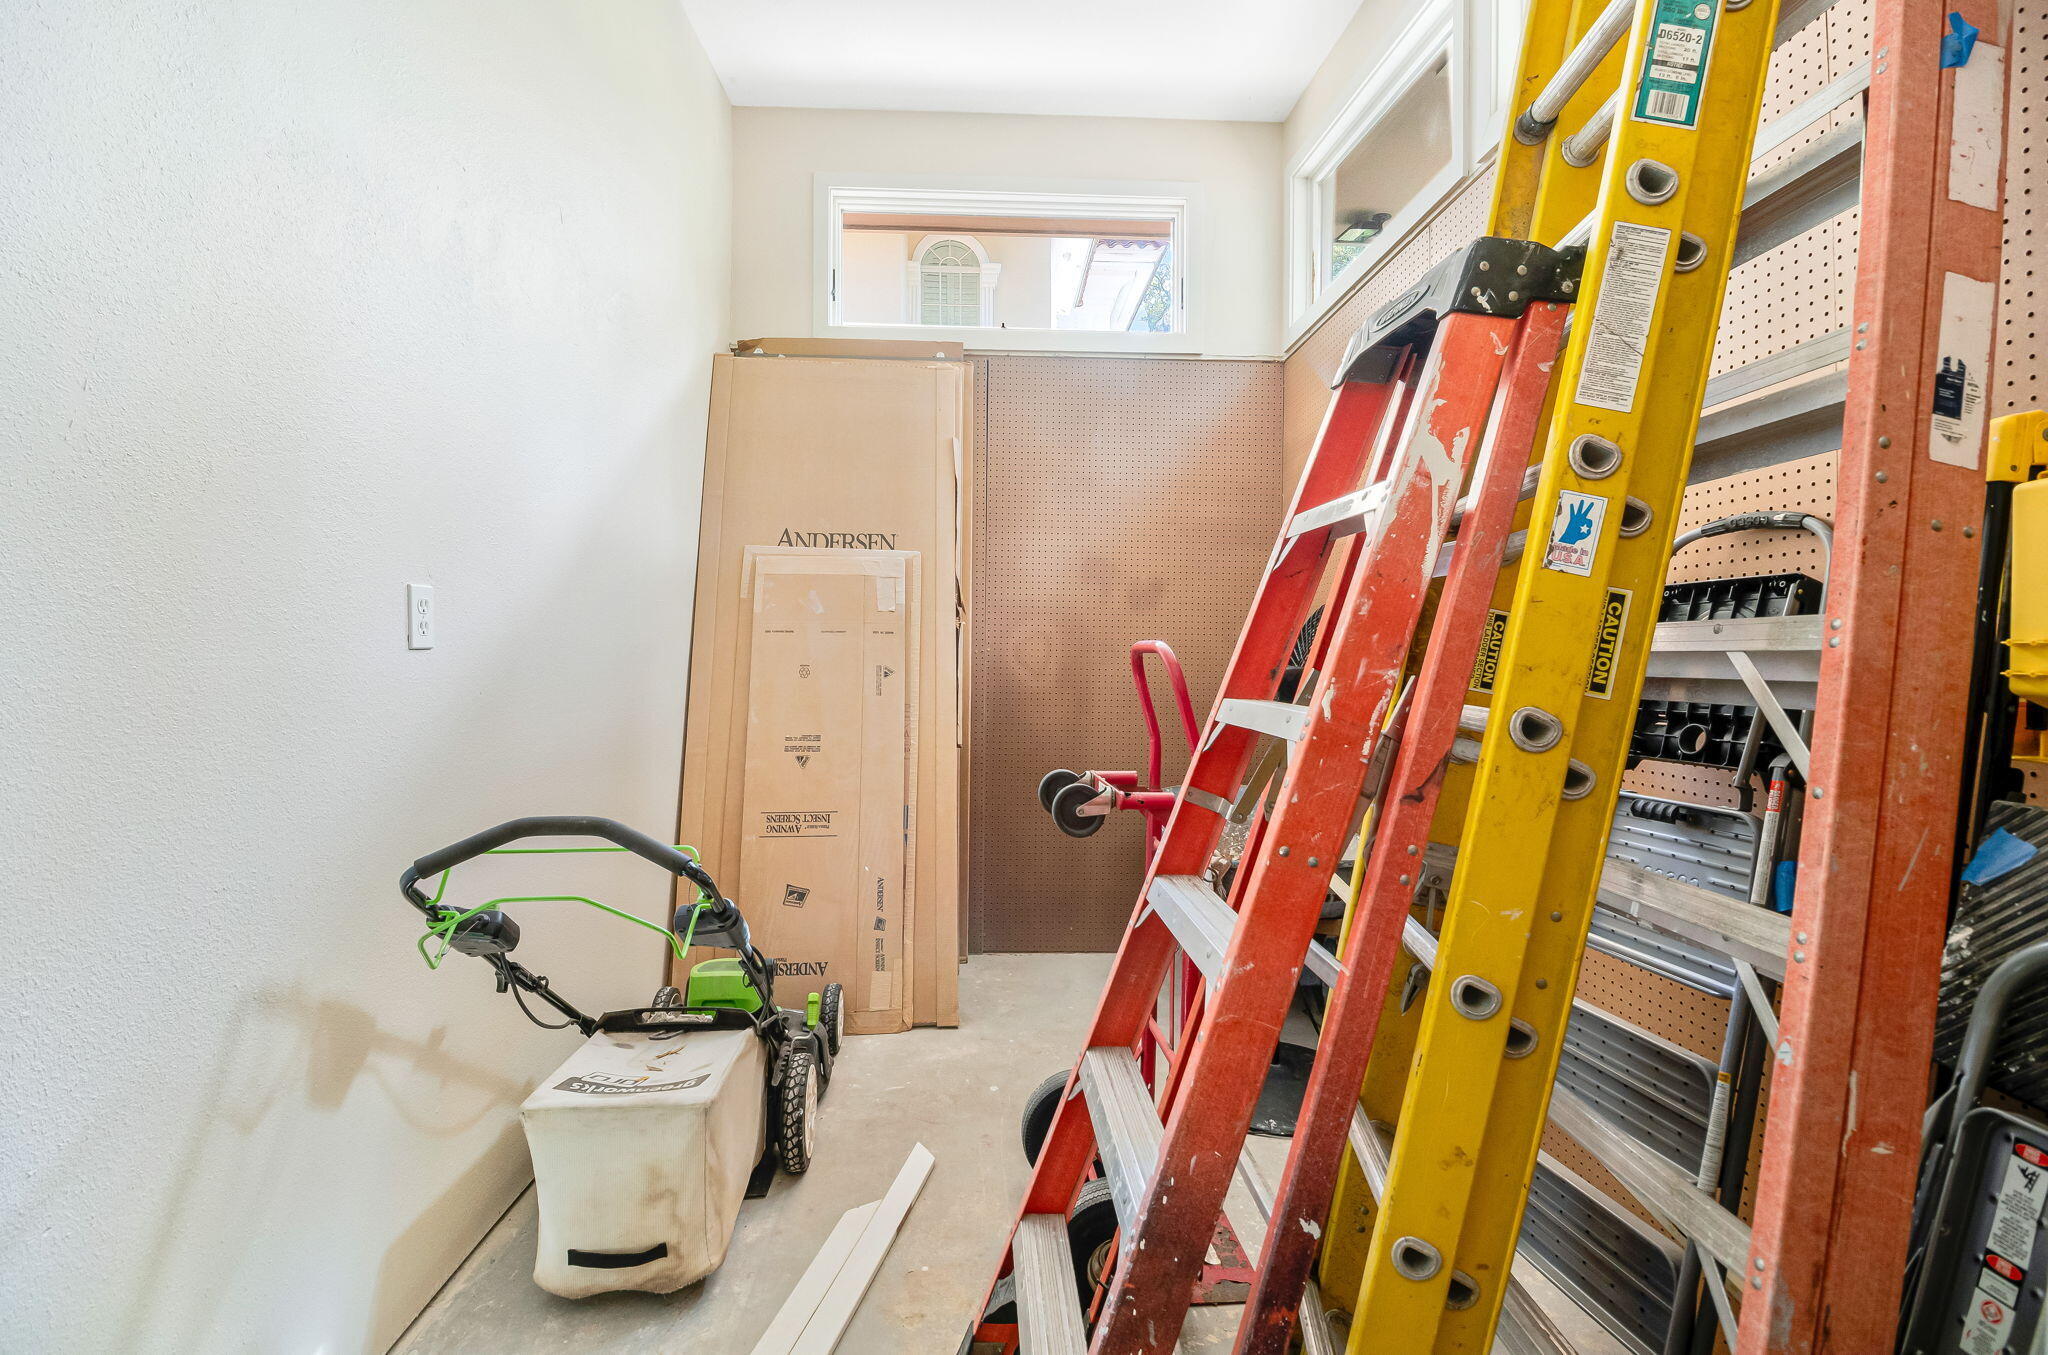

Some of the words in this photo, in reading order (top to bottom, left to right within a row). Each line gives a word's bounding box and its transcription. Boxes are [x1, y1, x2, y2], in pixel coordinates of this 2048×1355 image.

[777, 528, 897, 550] ANDERSEN
[1580, 547, 1589, 556] in
[1485, 611, 1494, 627] THIS
[1480, 627, 1490, 656] LADDER
[1593, 602, 1622, 686] CAUTION
[1482, 621, 1505, 688] CAUTION
[1474, 657, 1485, 689] SECTION
[766, 814, 801, 825] SCREENS
[802, 814, 831, 824] INSECT
[766, 824, 802, 834] AWNING
[877, 877, 885, 912] ANDERSEN
[773, 962, 828, 977] ANDERS
[569, 1079, 697, 1093] greenworks
